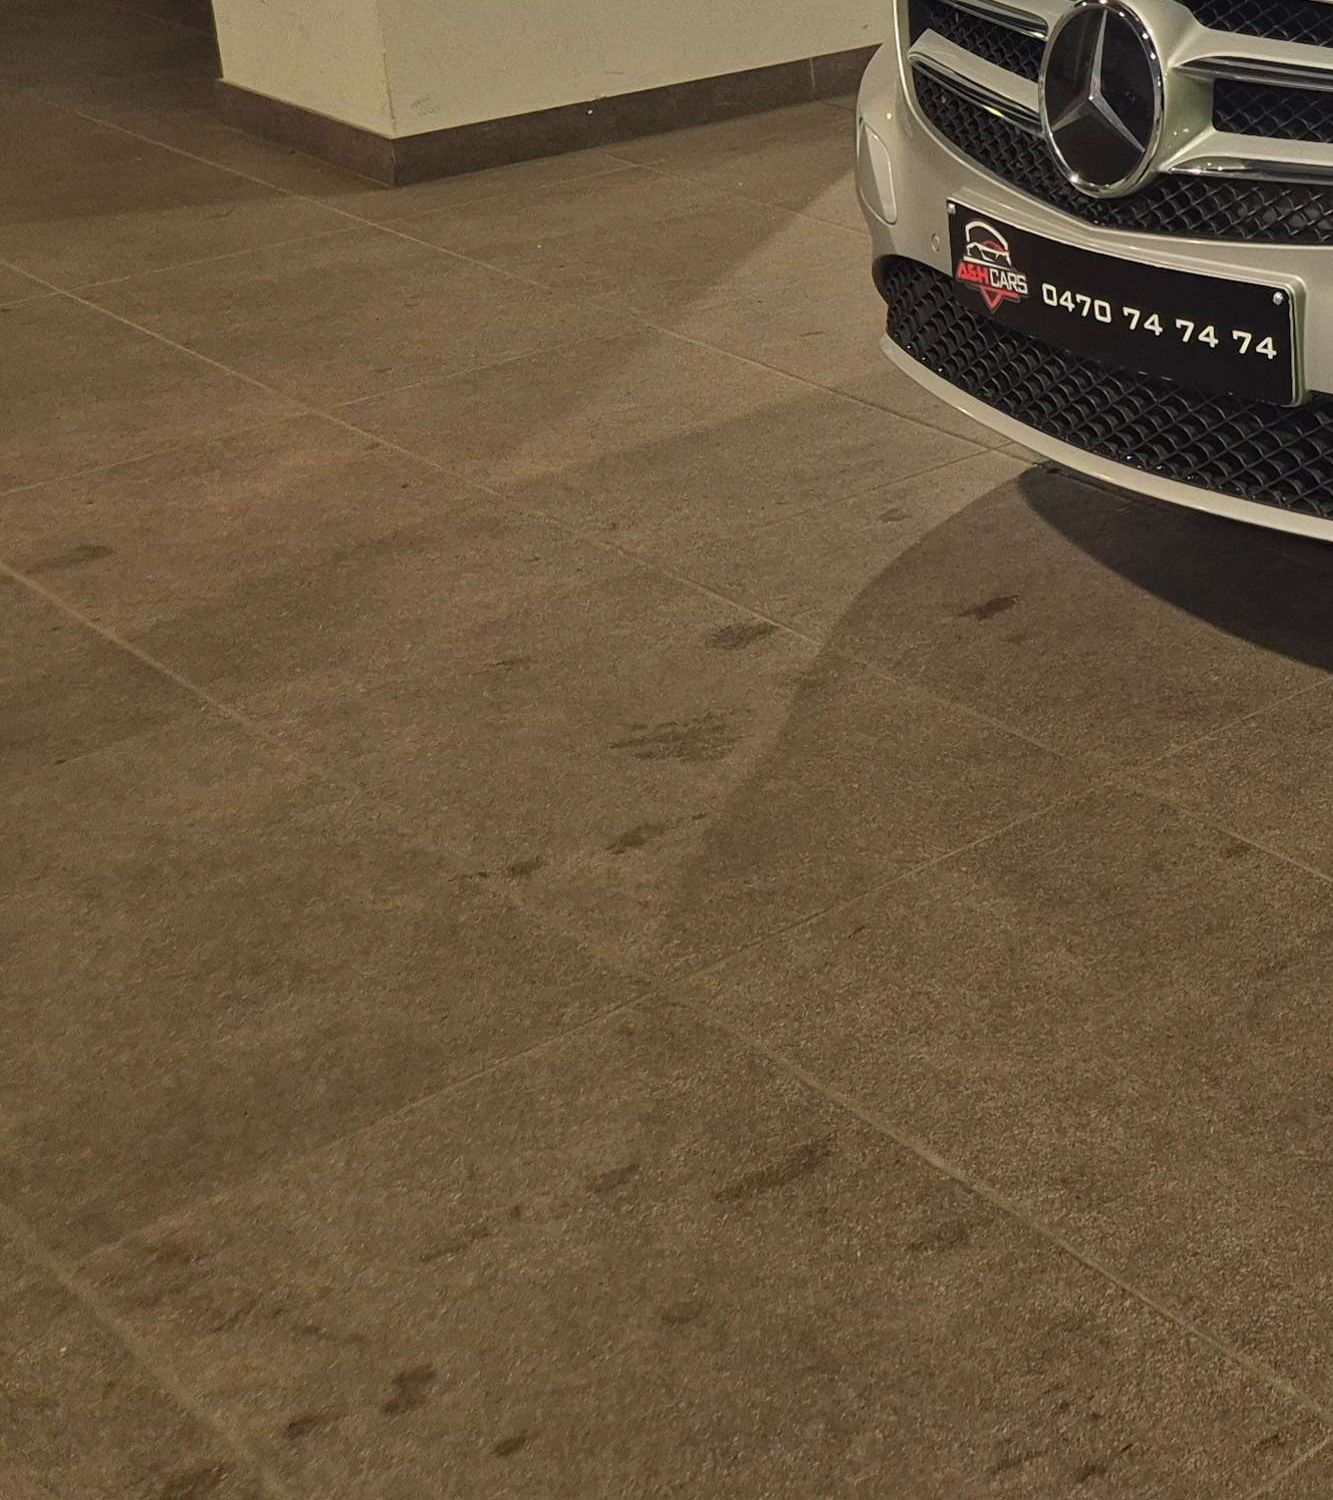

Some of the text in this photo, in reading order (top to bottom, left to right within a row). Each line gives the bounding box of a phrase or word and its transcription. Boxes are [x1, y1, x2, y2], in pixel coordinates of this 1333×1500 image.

[989, 267, 1028, 295] CARS
[1041, 283, 1278, 360] 0470 74 74 74
